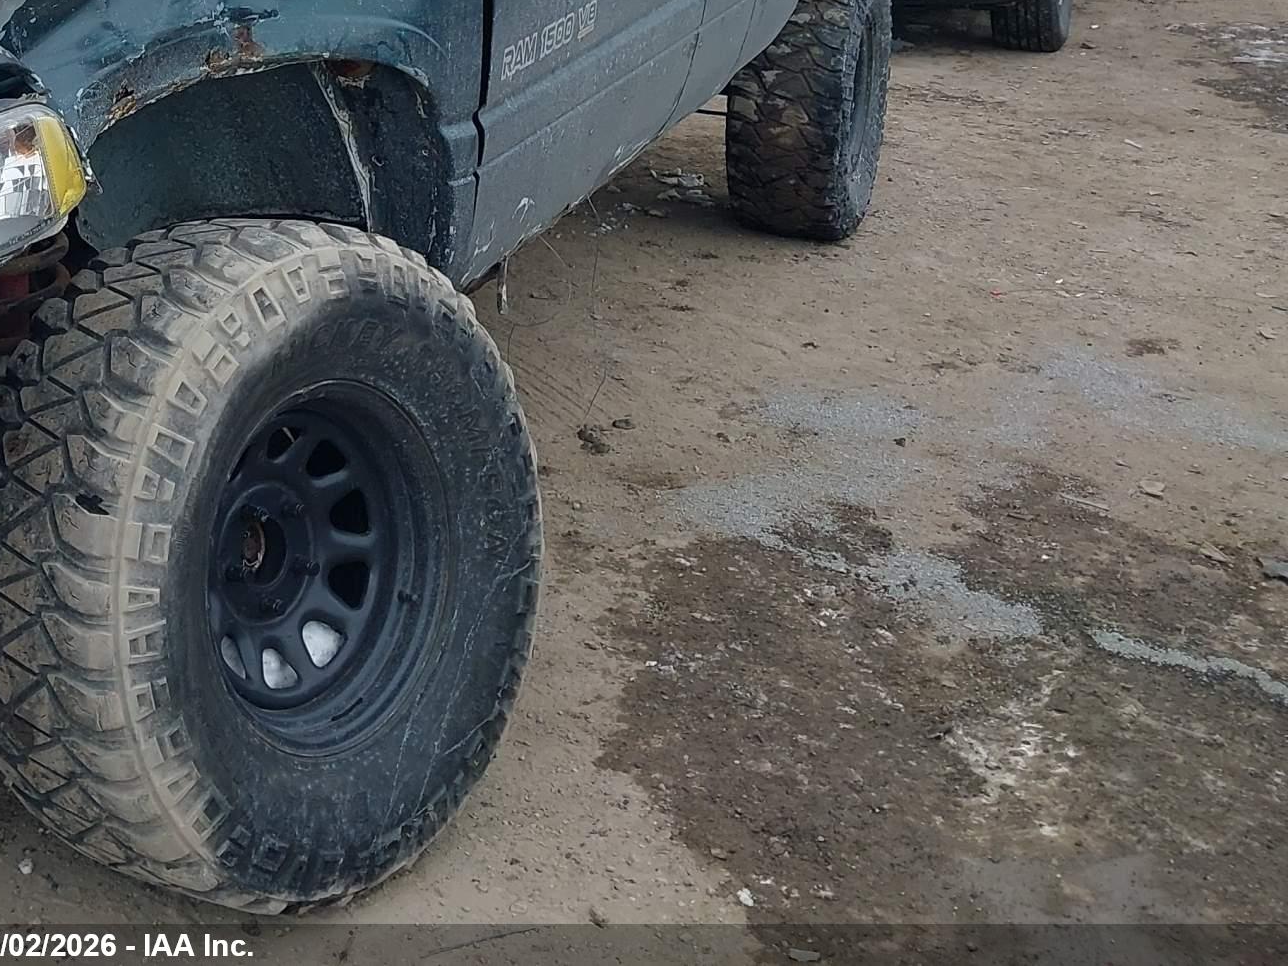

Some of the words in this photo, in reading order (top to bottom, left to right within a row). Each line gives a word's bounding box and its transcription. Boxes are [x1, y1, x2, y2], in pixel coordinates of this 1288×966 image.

[501, 32, 538, 81] RAM
[539, 12, 575, 62] 1500
[577, 0, 598, 31] V8
